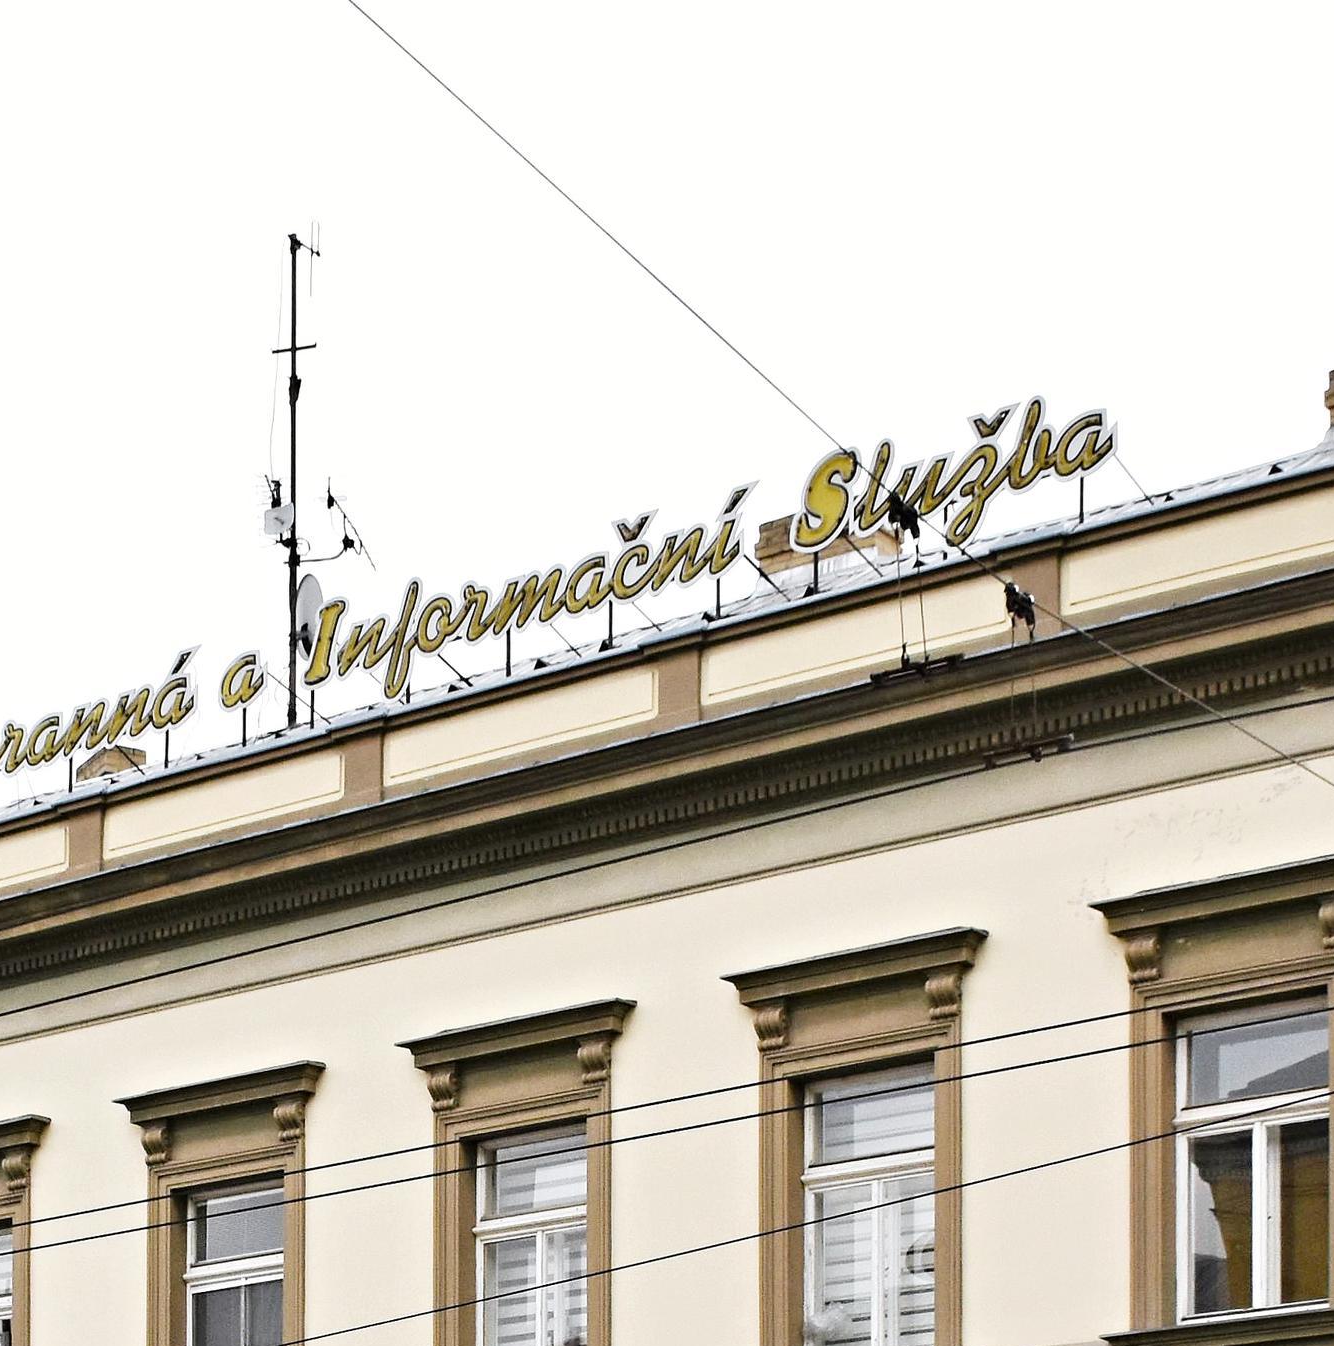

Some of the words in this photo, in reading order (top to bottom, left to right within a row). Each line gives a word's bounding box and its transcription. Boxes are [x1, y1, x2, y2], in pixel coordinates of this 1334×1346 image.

[219, 650, 266, 711] a
[300, 480, 759, 702] Informační
[789, 395, 1117, 552] Služba
